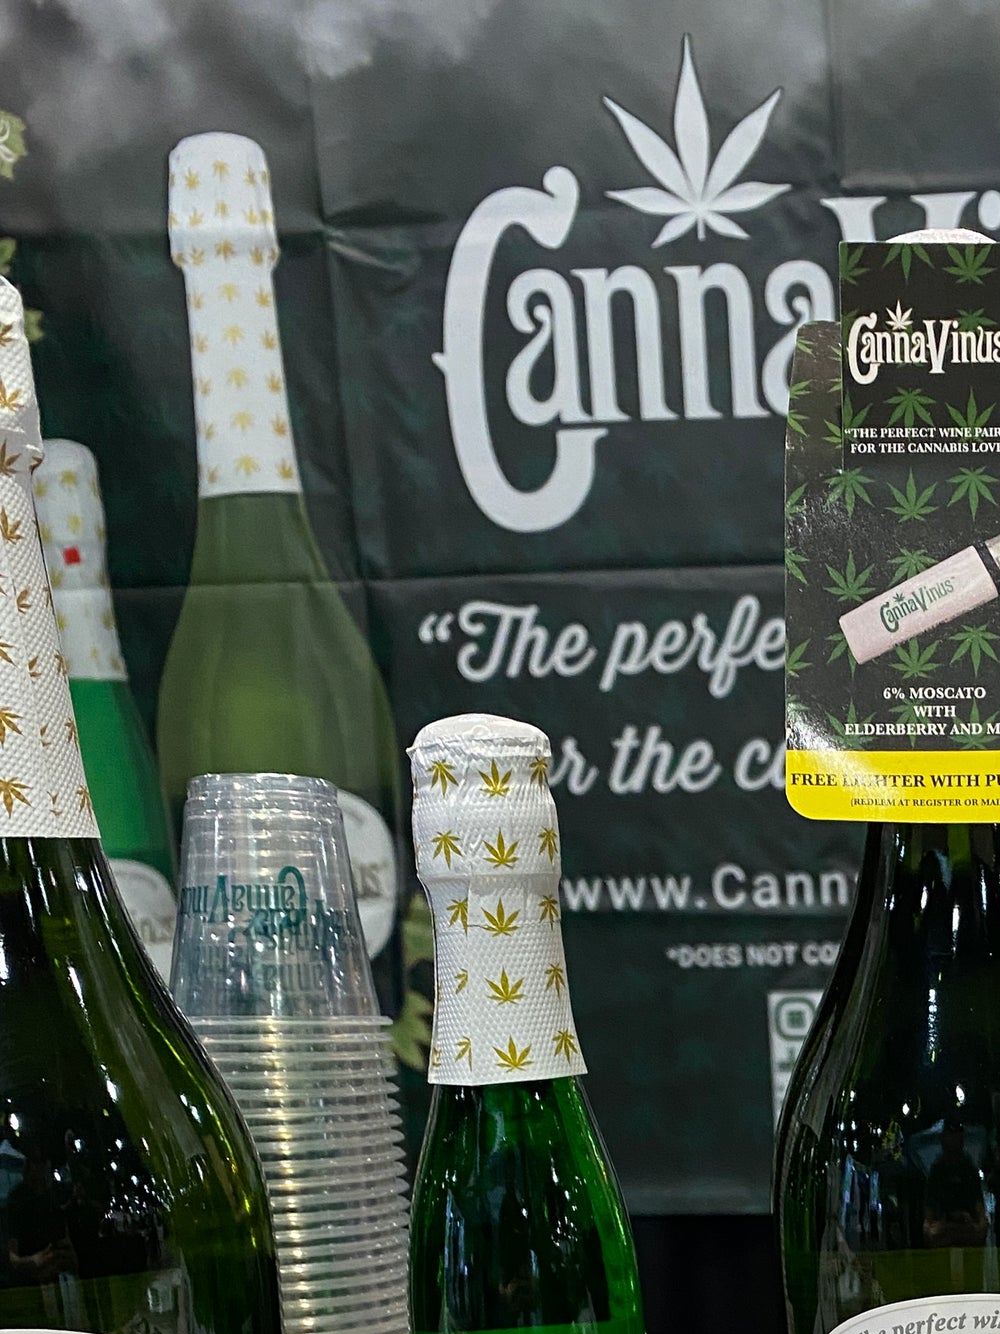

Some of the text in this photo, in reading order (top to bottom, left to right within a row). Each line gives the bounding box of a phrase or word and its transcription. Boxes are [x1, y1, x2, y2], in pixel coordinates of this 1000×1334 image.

[880, 428, 935, 438] PERFECT
[939, 428, 971, 438] WINE
[851, 443, 876, 453] FOR
[879, 443, 905, 453] THE
[908, 443, 969, 453] CANNABIS
[600, 595, 785, 698] perfe
[883, 687, 986, 700] 6% MOSCATO
[913, 706, 955, 717] WITH
[845, 724, 945, 736] ELDERBERRY
[950, 724, 982, 735] AND
[610, 726, 721, 794] the
[791, 773, 837, 787] FREE
[842, 774, 925, 788] LIHTER
[931, 774, 981, 787] WITH
[898, 798, 909, 807] AT
[912, 798, 961, 807] REGISTER
[964, 798, 978, 807] OR
[747, 942, 798, 966] NOT
